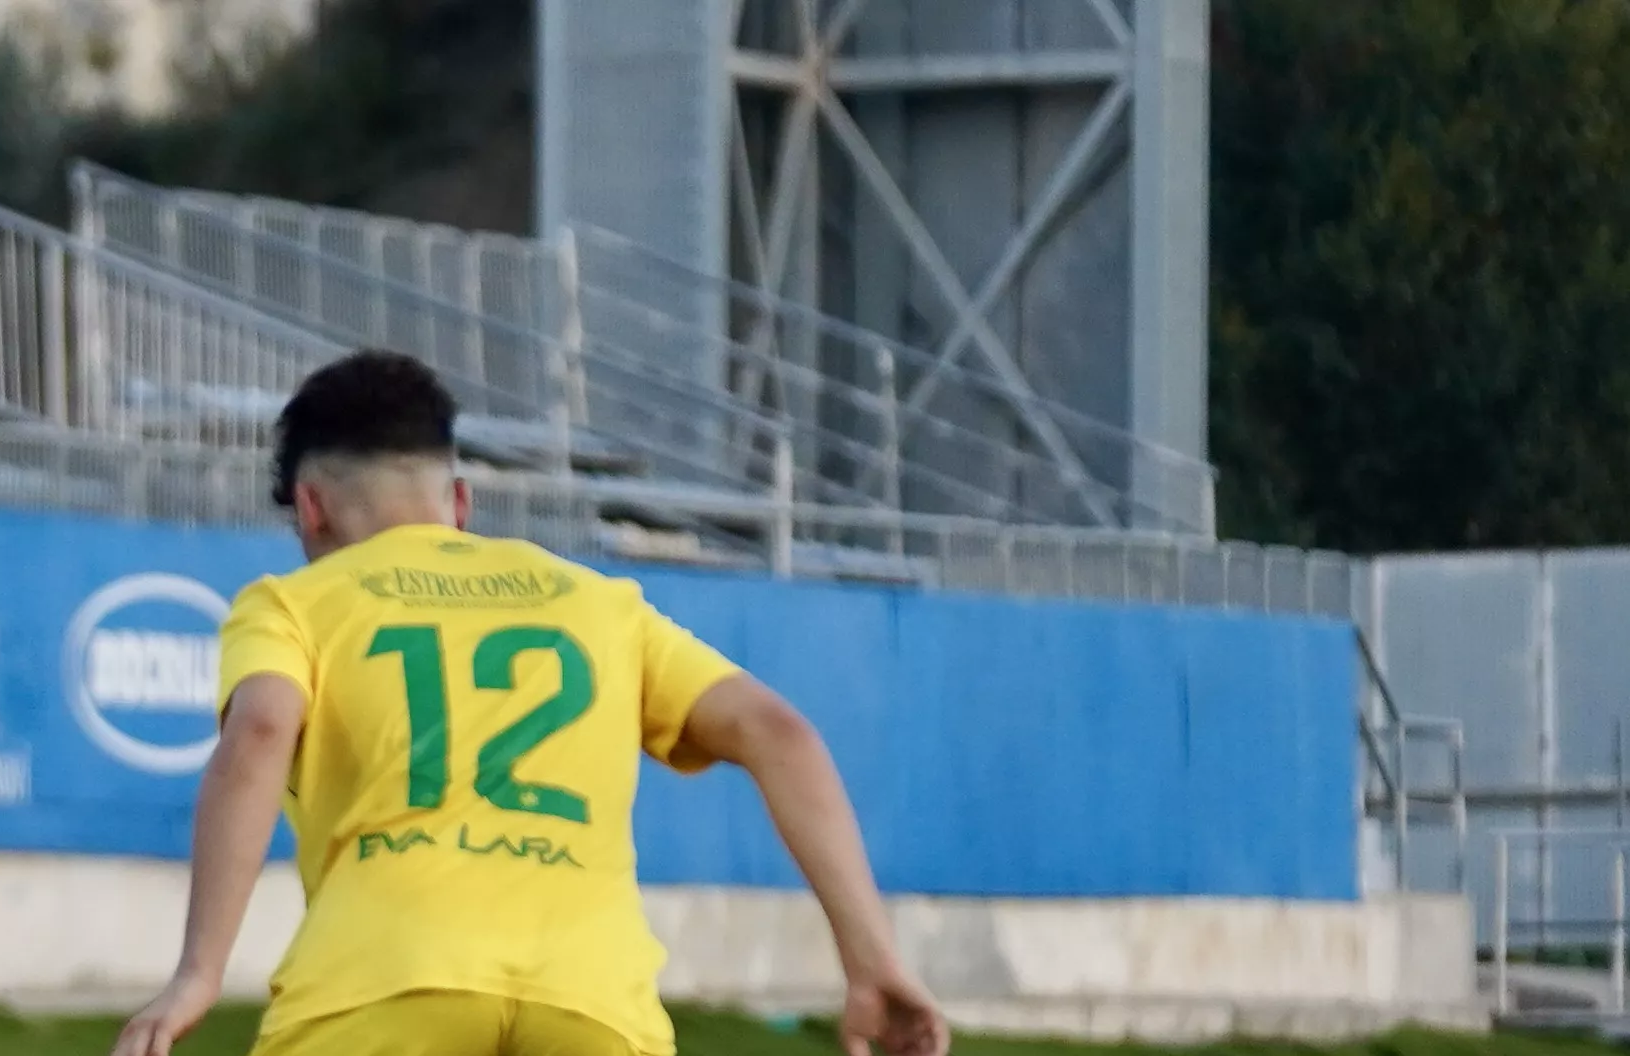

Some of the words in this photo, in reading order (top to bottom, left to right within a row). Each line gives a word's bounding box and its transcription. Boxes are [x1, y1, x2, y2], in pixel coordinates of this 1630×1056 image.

[393, 566, 545, 598] ESTRUCONSA
[364, 622, 597, 824] 12
[358, 826, 438, 863] EVA
[458, 821, 586, 870] LARA
